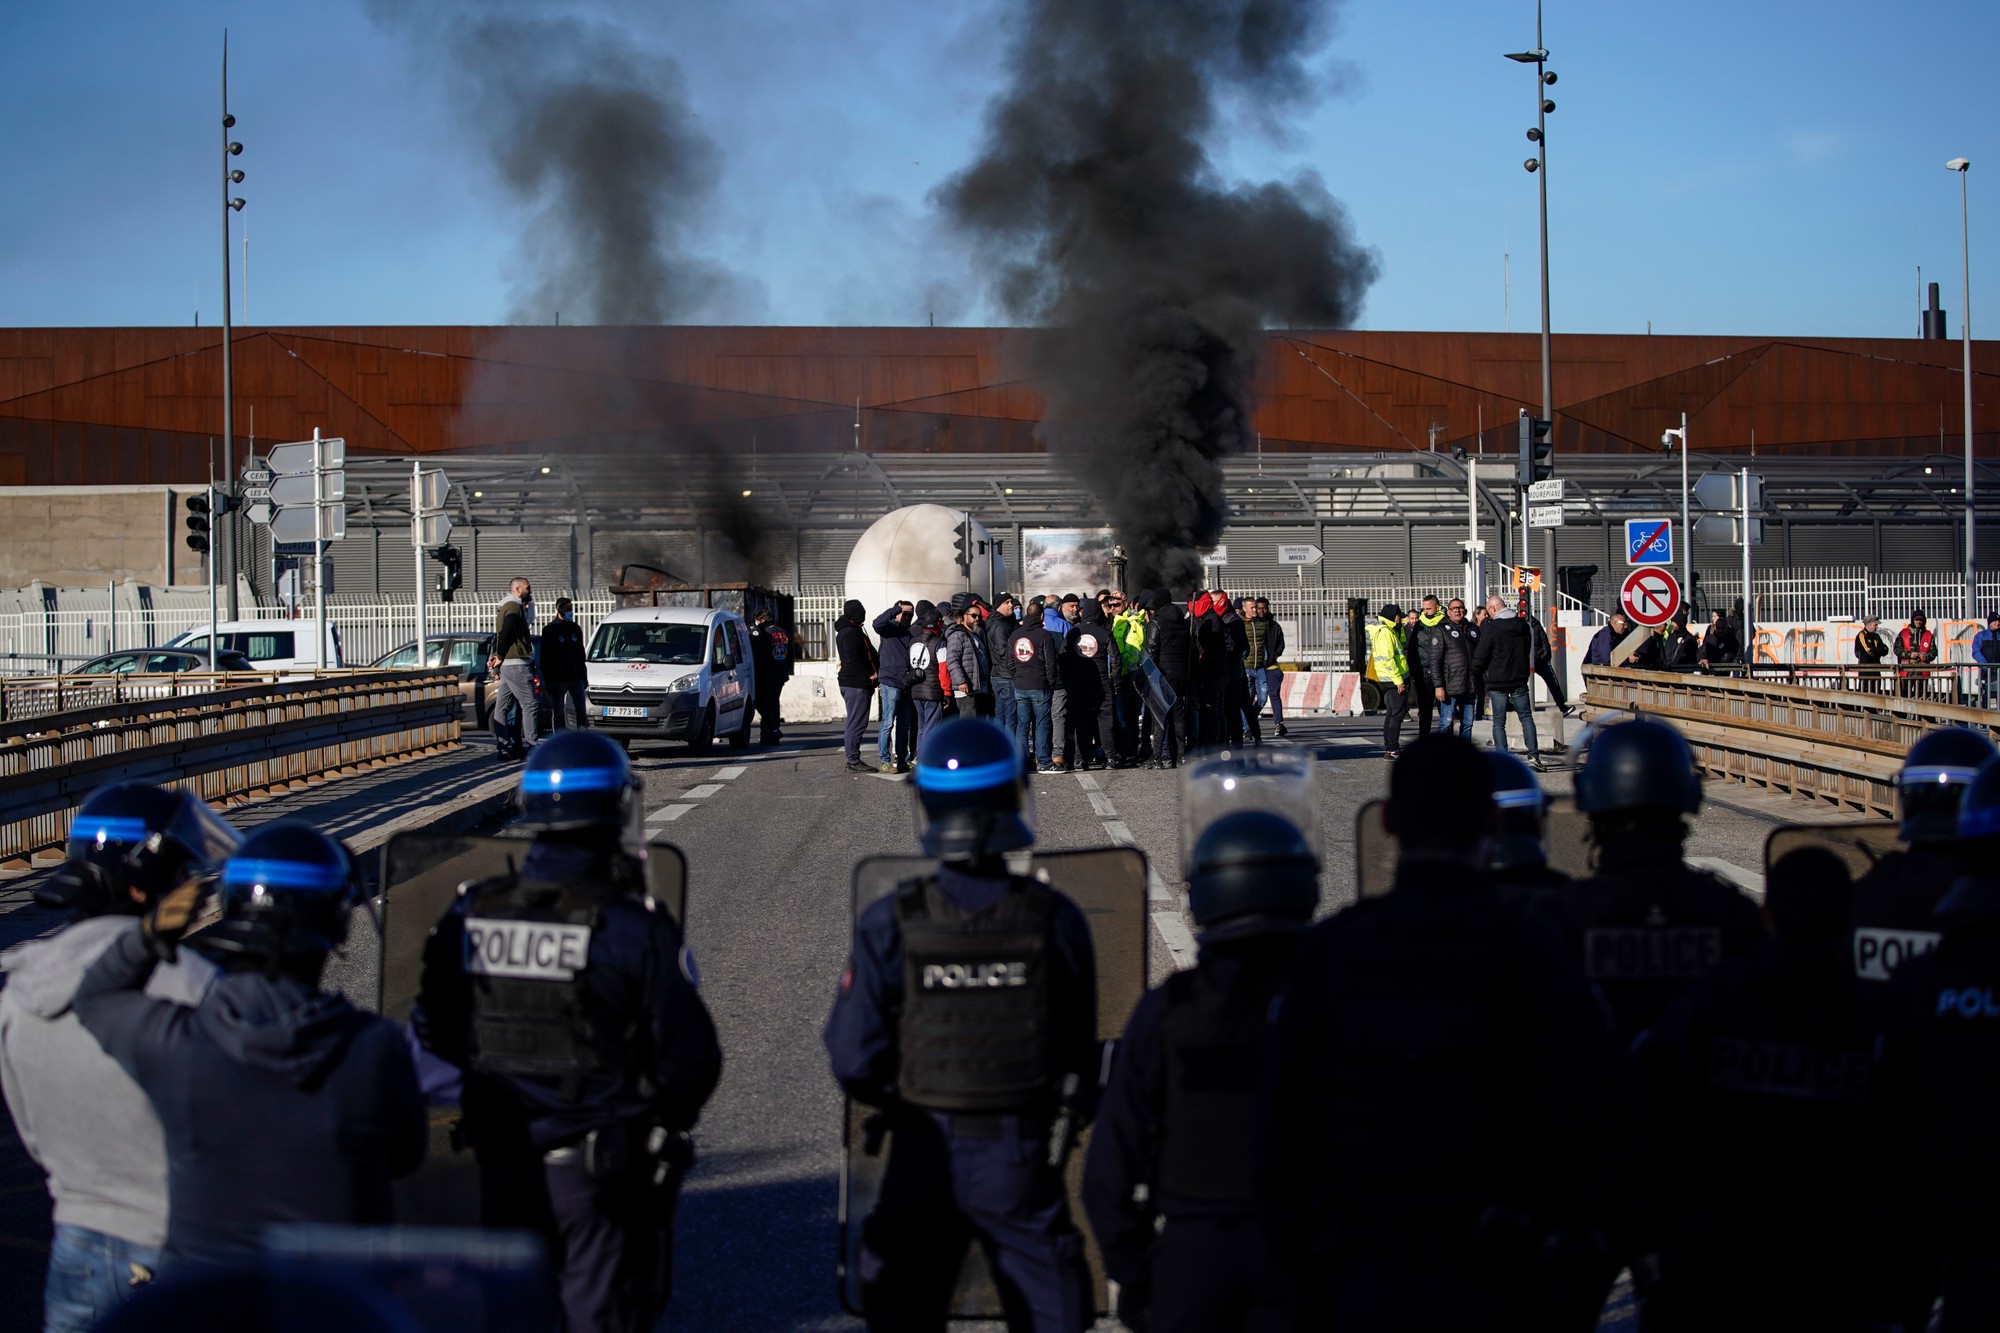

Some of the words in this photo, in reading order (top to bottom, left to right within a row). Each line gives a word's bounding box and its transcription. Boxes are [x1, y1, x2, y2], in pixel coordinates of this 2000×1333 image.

[250, 472, 274, 480] CENTR
[250, 489, 262, 497] LES
[469, 927, 577, 969] POLICE
[1594, 933, 1714, 973] POLICE
[923, 961, 1027, 989] POLICE
